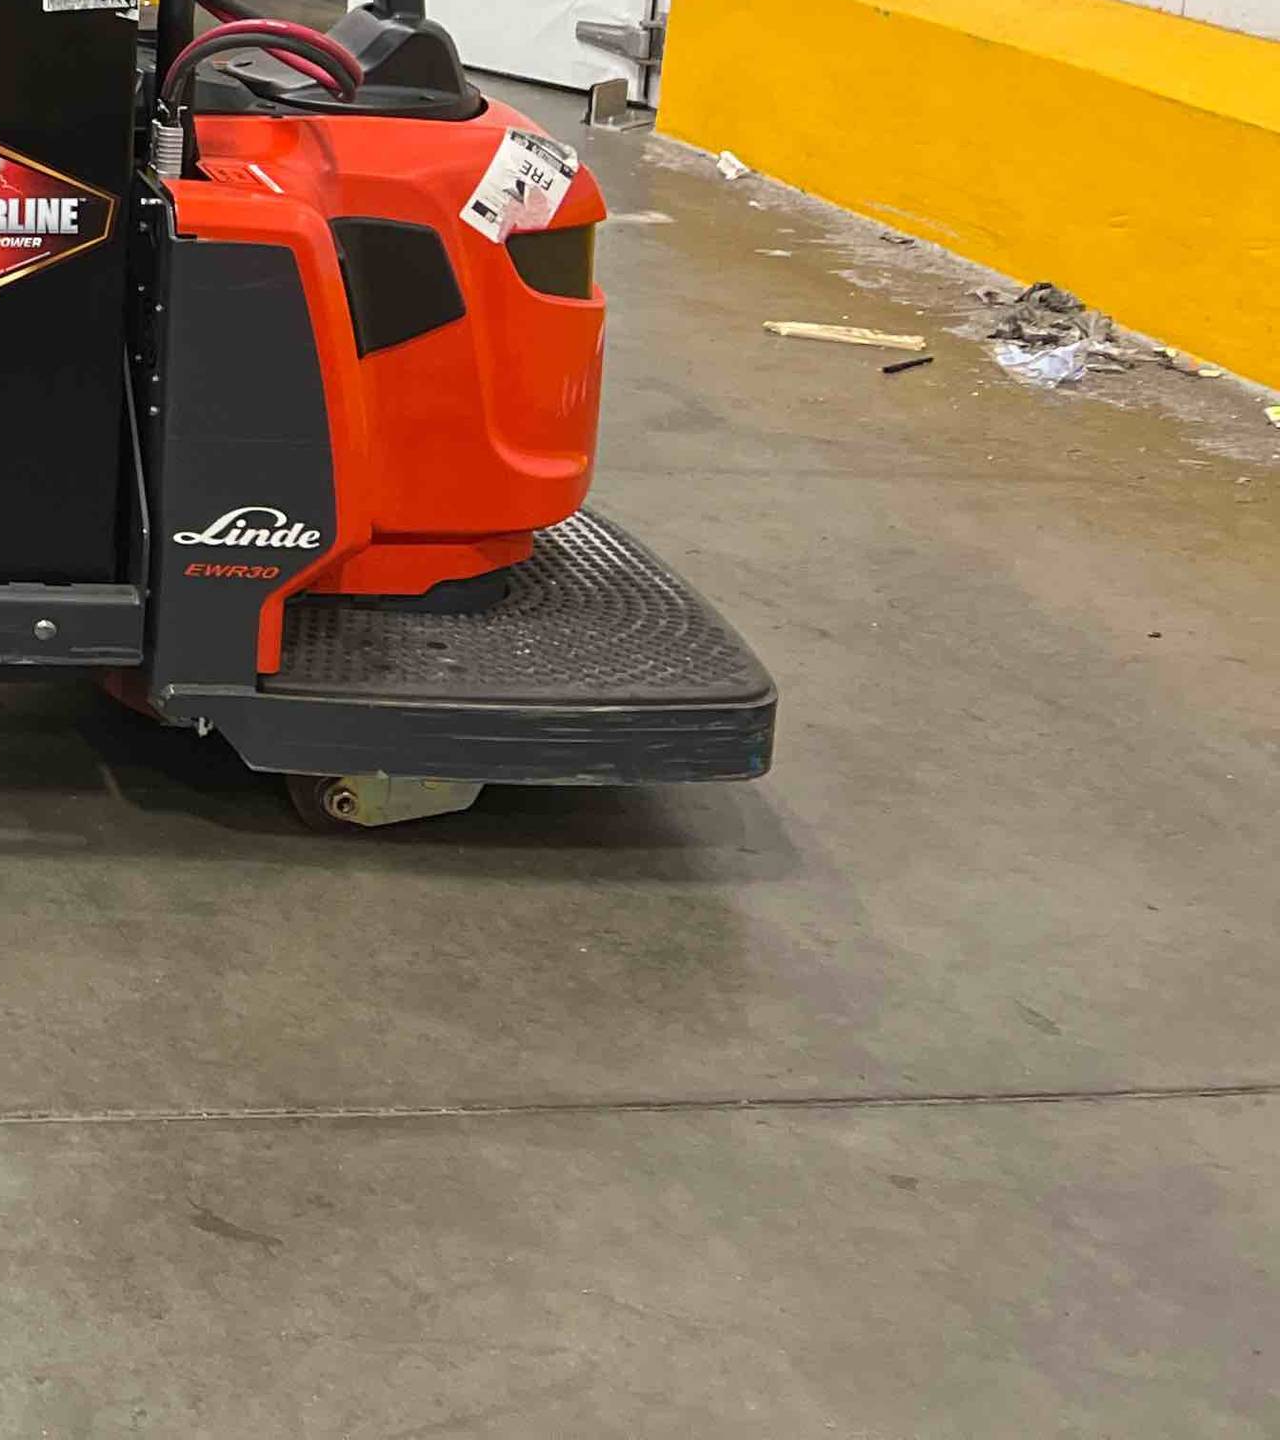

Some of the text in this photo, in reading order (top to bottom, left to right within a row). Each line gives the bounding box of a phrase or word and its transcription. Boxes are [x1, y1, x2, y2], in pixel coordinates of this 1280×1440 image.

[519, 159, 554, 192] FRE
[173, 506, 321, 549] Linde
[184, 563, 280, 579] EWR30
